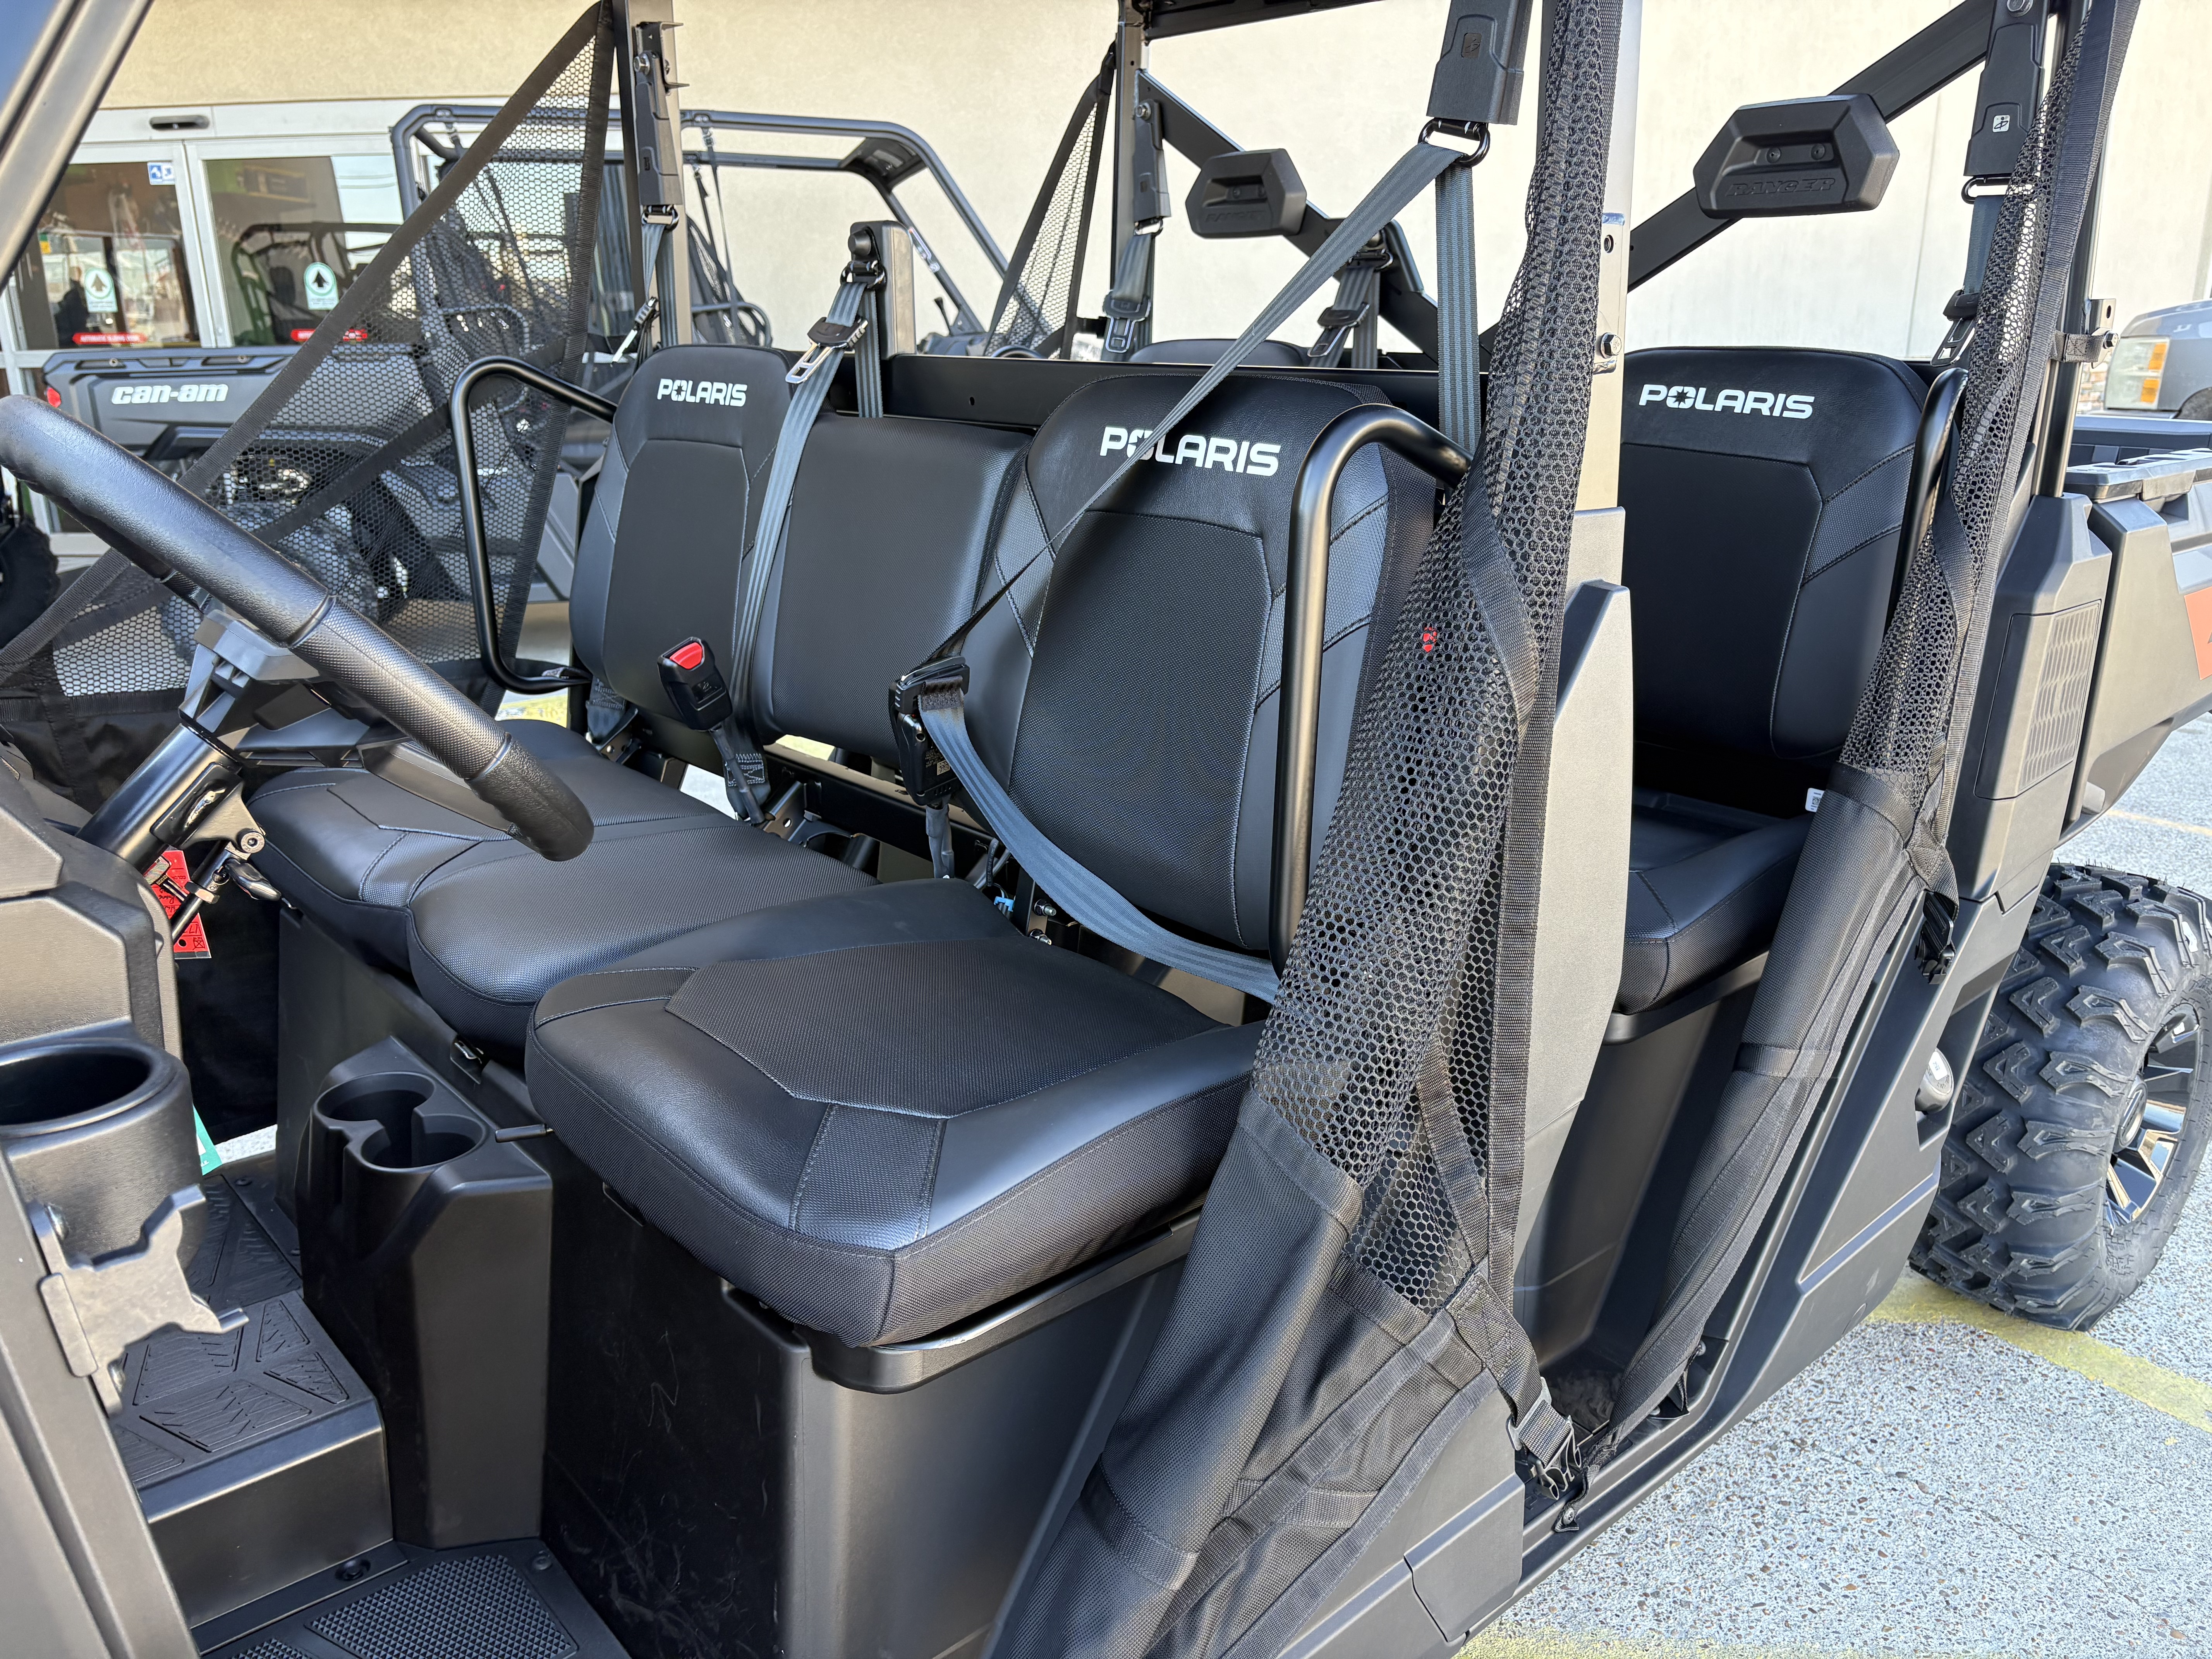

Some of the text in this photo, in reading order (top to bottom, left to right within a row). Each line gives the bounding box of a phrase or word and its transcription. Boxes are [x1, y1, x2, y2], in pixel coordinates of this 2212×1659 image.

[1725, 177, 1836, 196] RANGER
[112, 384, 228, 404] can-am
[657, 378, 747, 407] POLARIS
[1639, 384, 1815, 419] POLARIS
[1100, 426, 1281, 477] POLARIS
